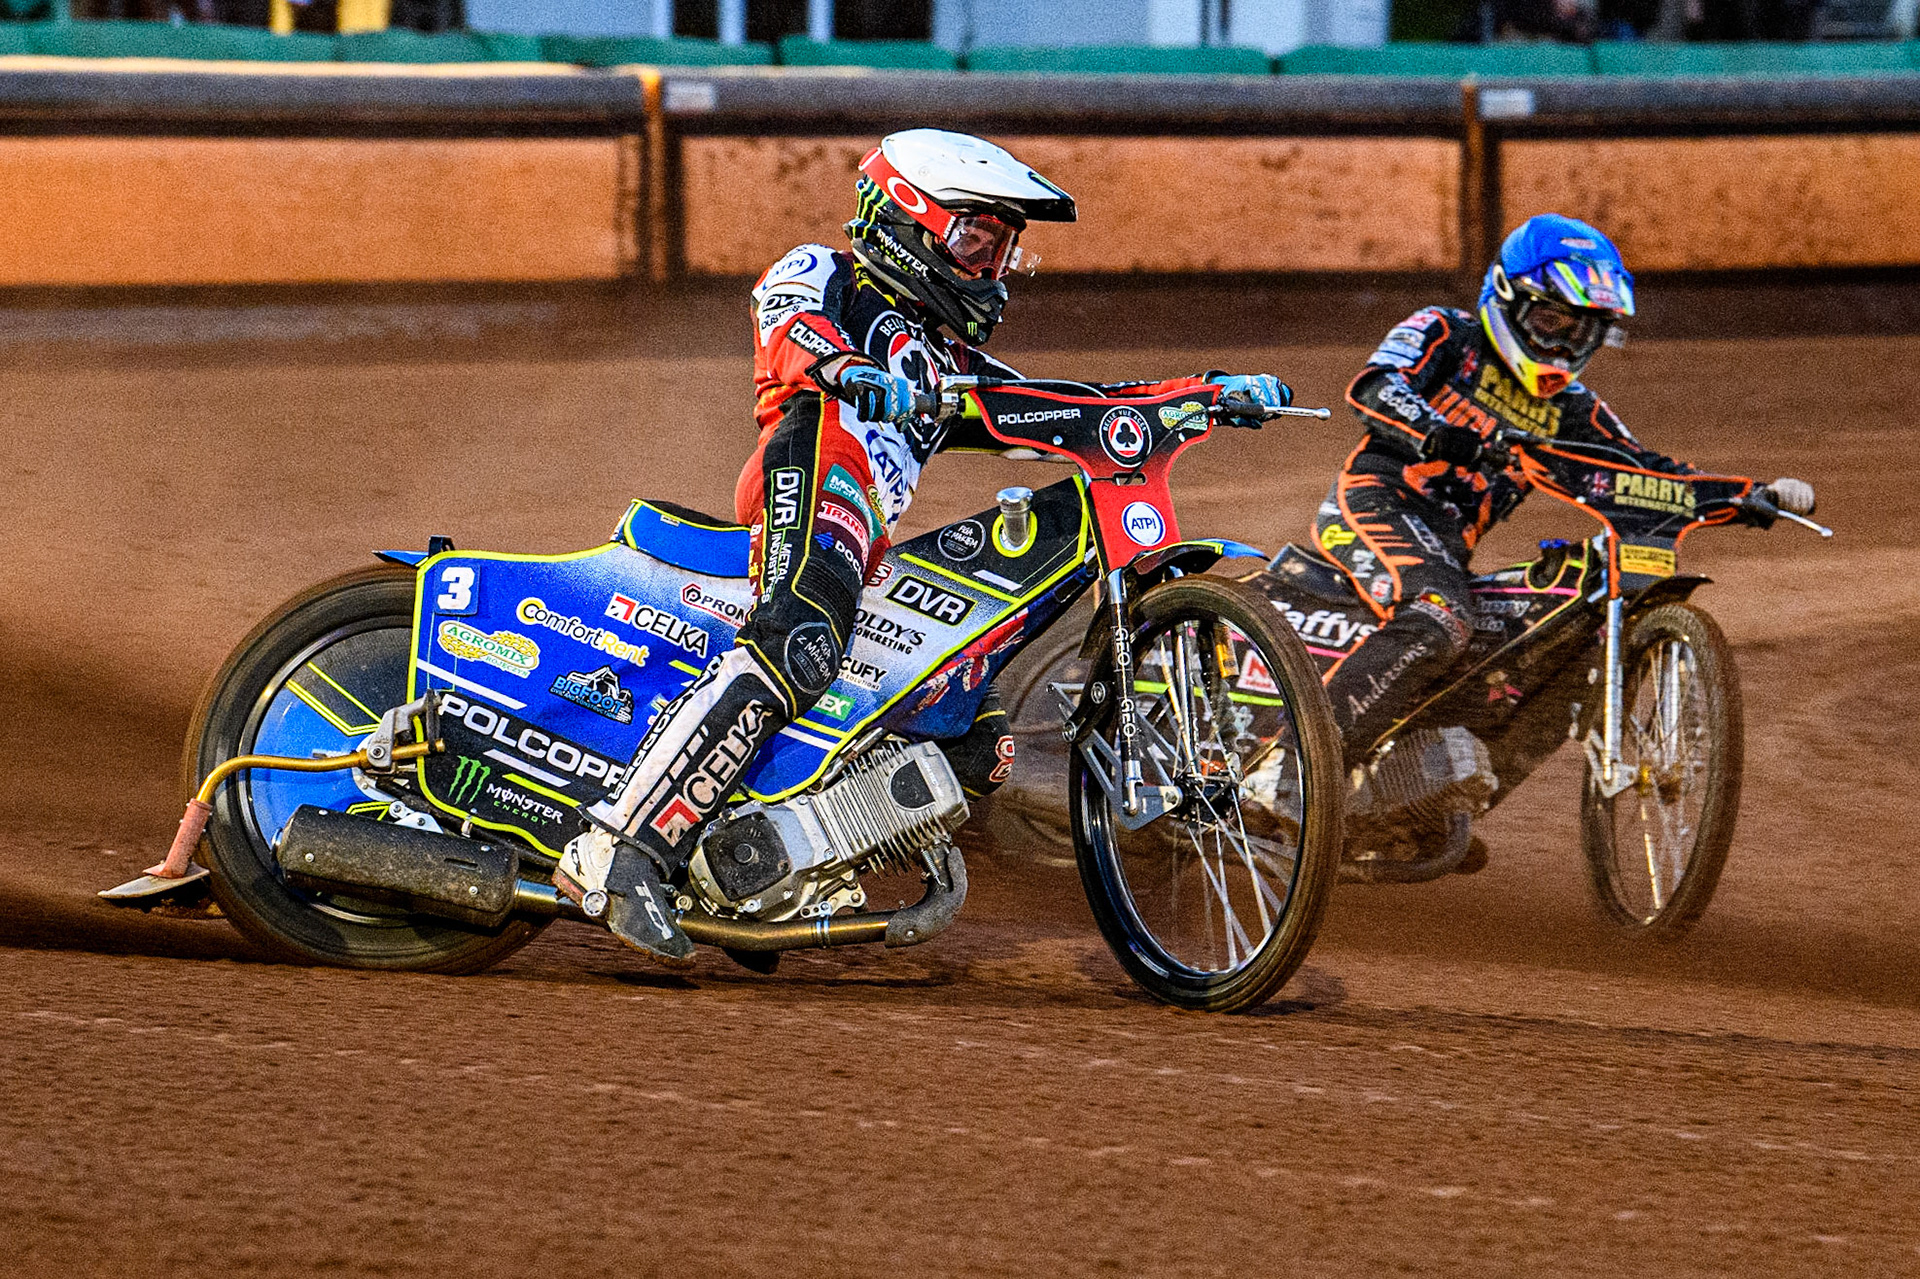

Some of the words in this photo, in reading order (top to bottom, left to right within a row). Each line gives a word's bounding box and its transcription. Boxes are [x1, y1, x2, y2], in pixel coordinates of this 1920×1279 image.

[998, 408, 1081, 425] POLCOPPER
[1103, 412, 1117, 431] BELLE
[1133, 415, 1147, 431] ACES
[774, 472, 800, 526] DVR
[1131, 516, 1157, 531] ATPI
[437, 567, 475, 610] 3
[893, 579, 966, 622] DVR
[447, 626, 529, 665] AGROMIX
[634, 607, 707, 656] CELKA
[1115, 628, 1130, 666] GEO
[553, 676, 625, 714] BIGFOOT
[1121, 699, 1136, 737] GEO
[486, 783, 563, 824] MONSTER
[493, 800, 548, 826] ENERGY
